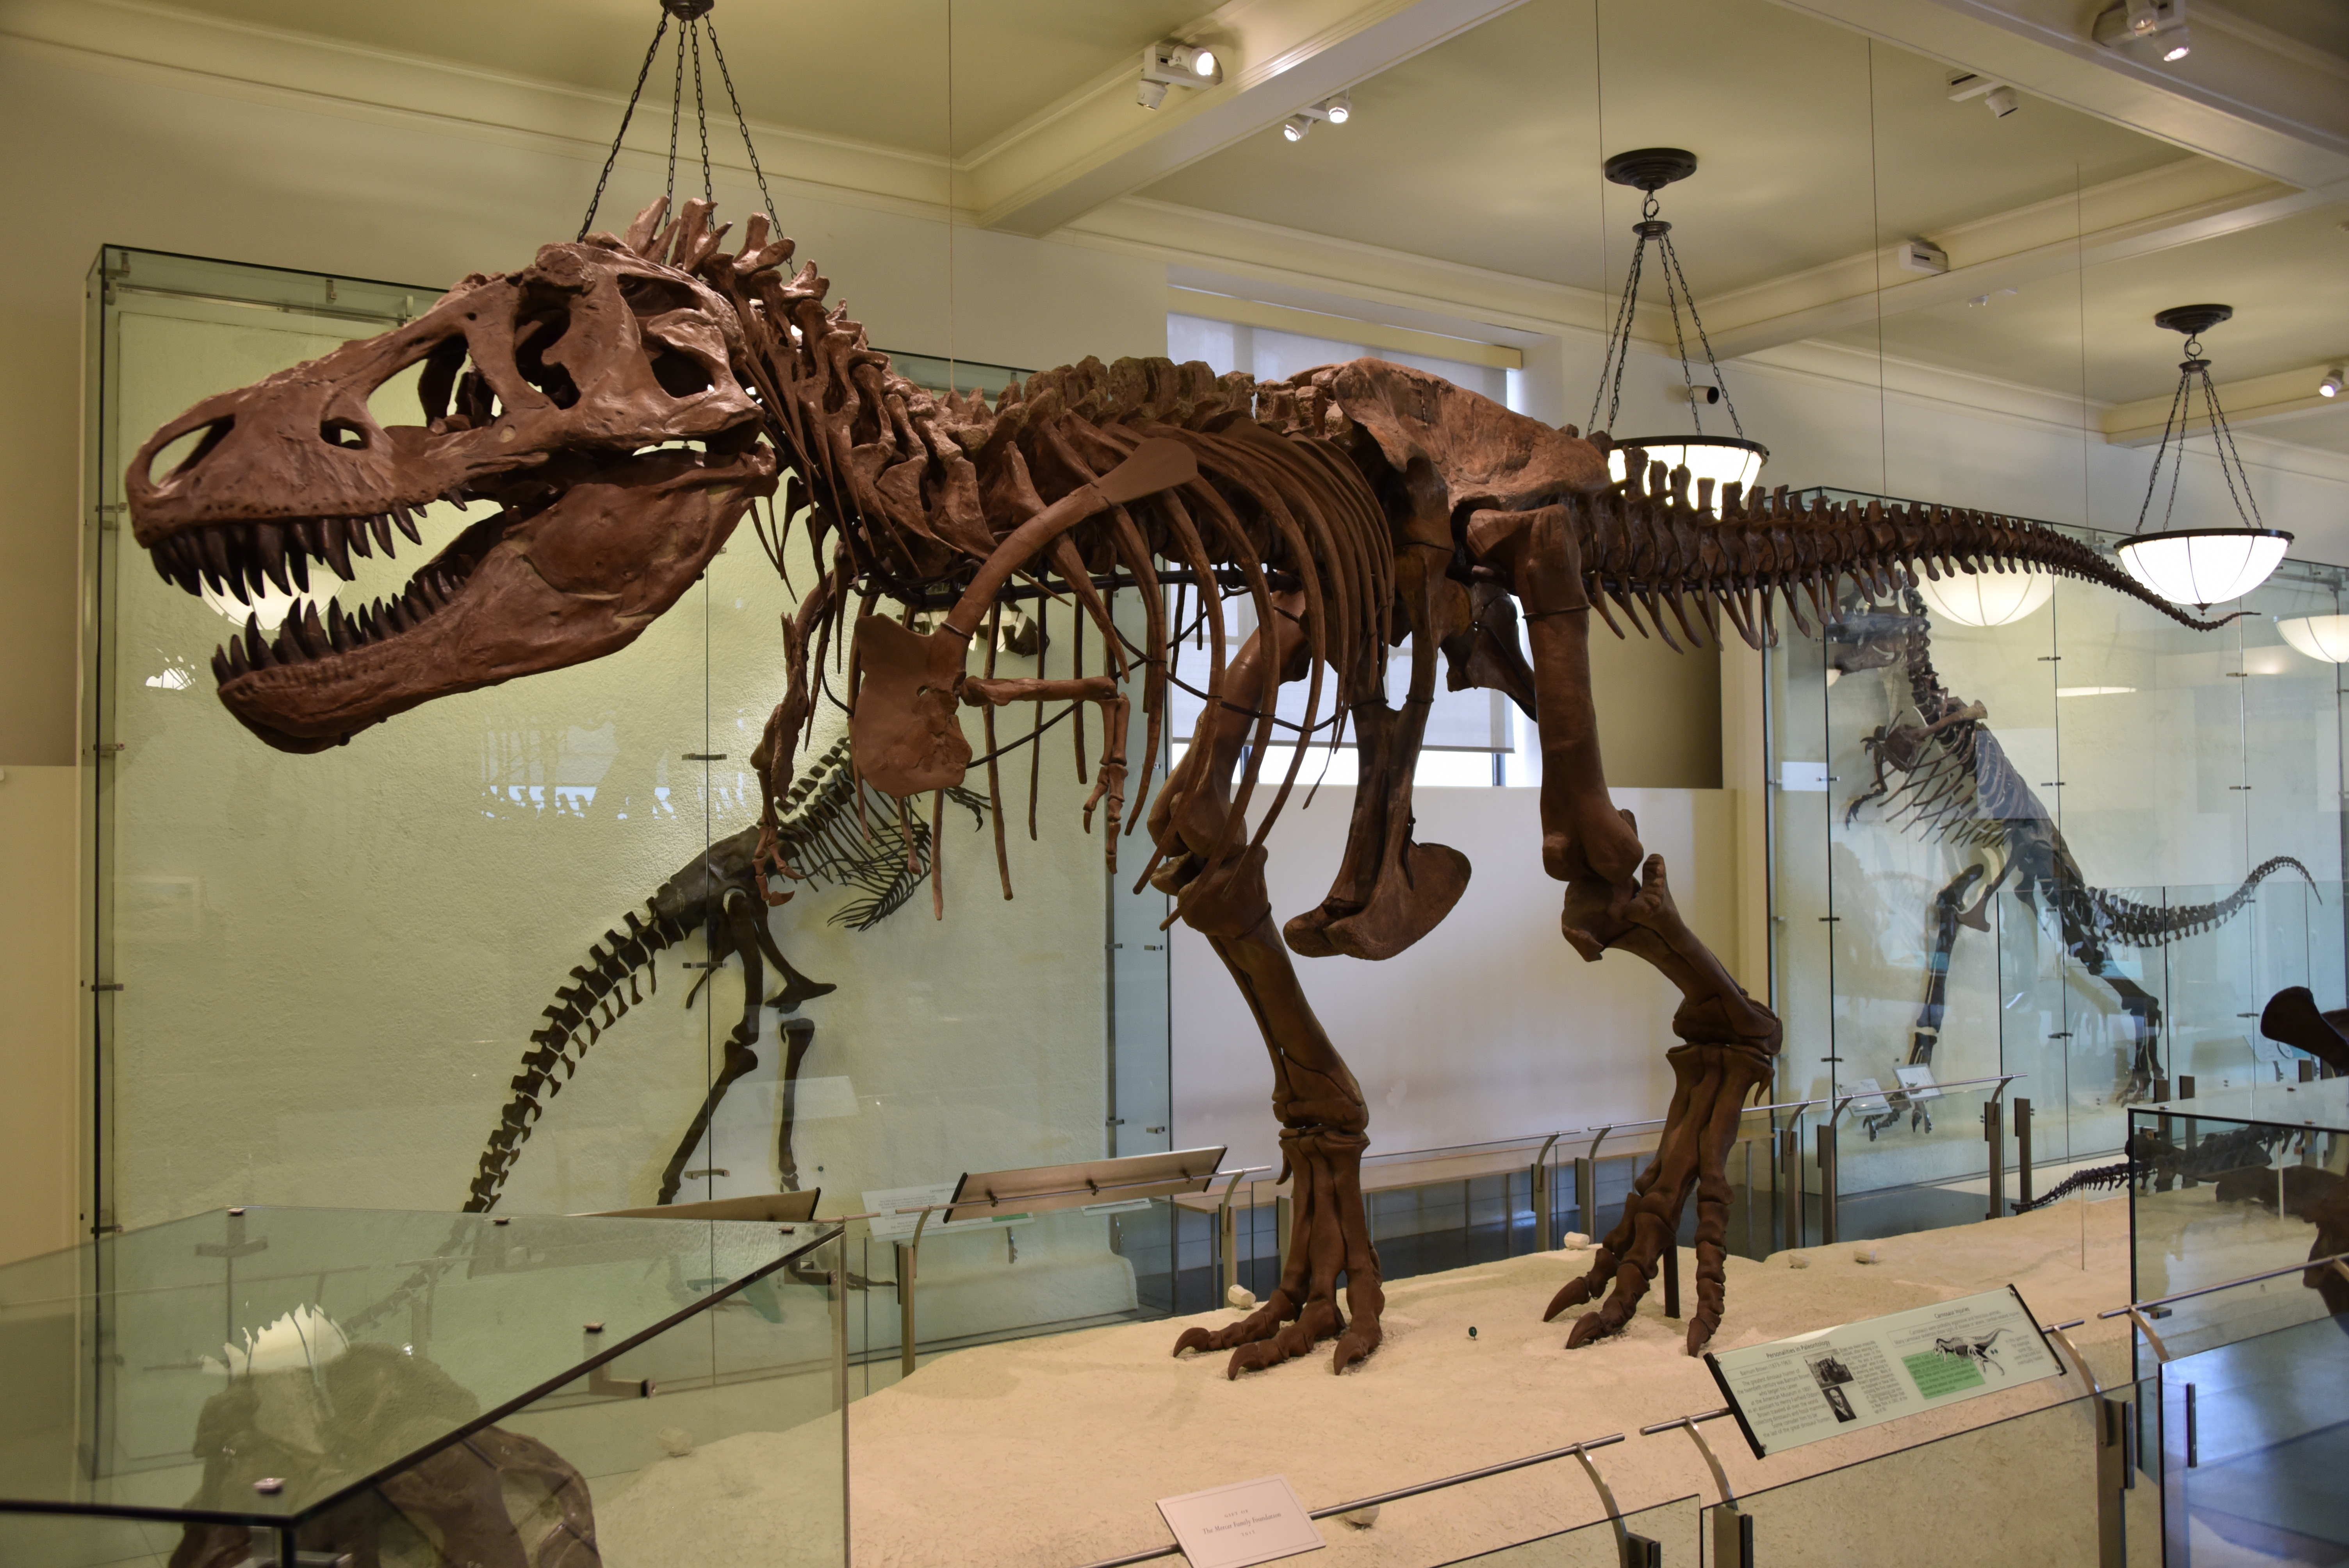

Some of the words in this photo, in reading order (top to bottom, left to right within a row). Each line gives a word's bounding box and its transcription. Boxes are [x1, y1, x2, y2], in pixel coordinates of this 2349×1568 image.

[1934, 1310, 1955, 1319] Carnosaur
[1766, 1348, 1796, 1359] Personalities
[1800, 1340, 1830, 1351] Paleontology
[1233, 1518, 1251, 1527] Family
[1252, 1513, 1281, 1523] Foundation
